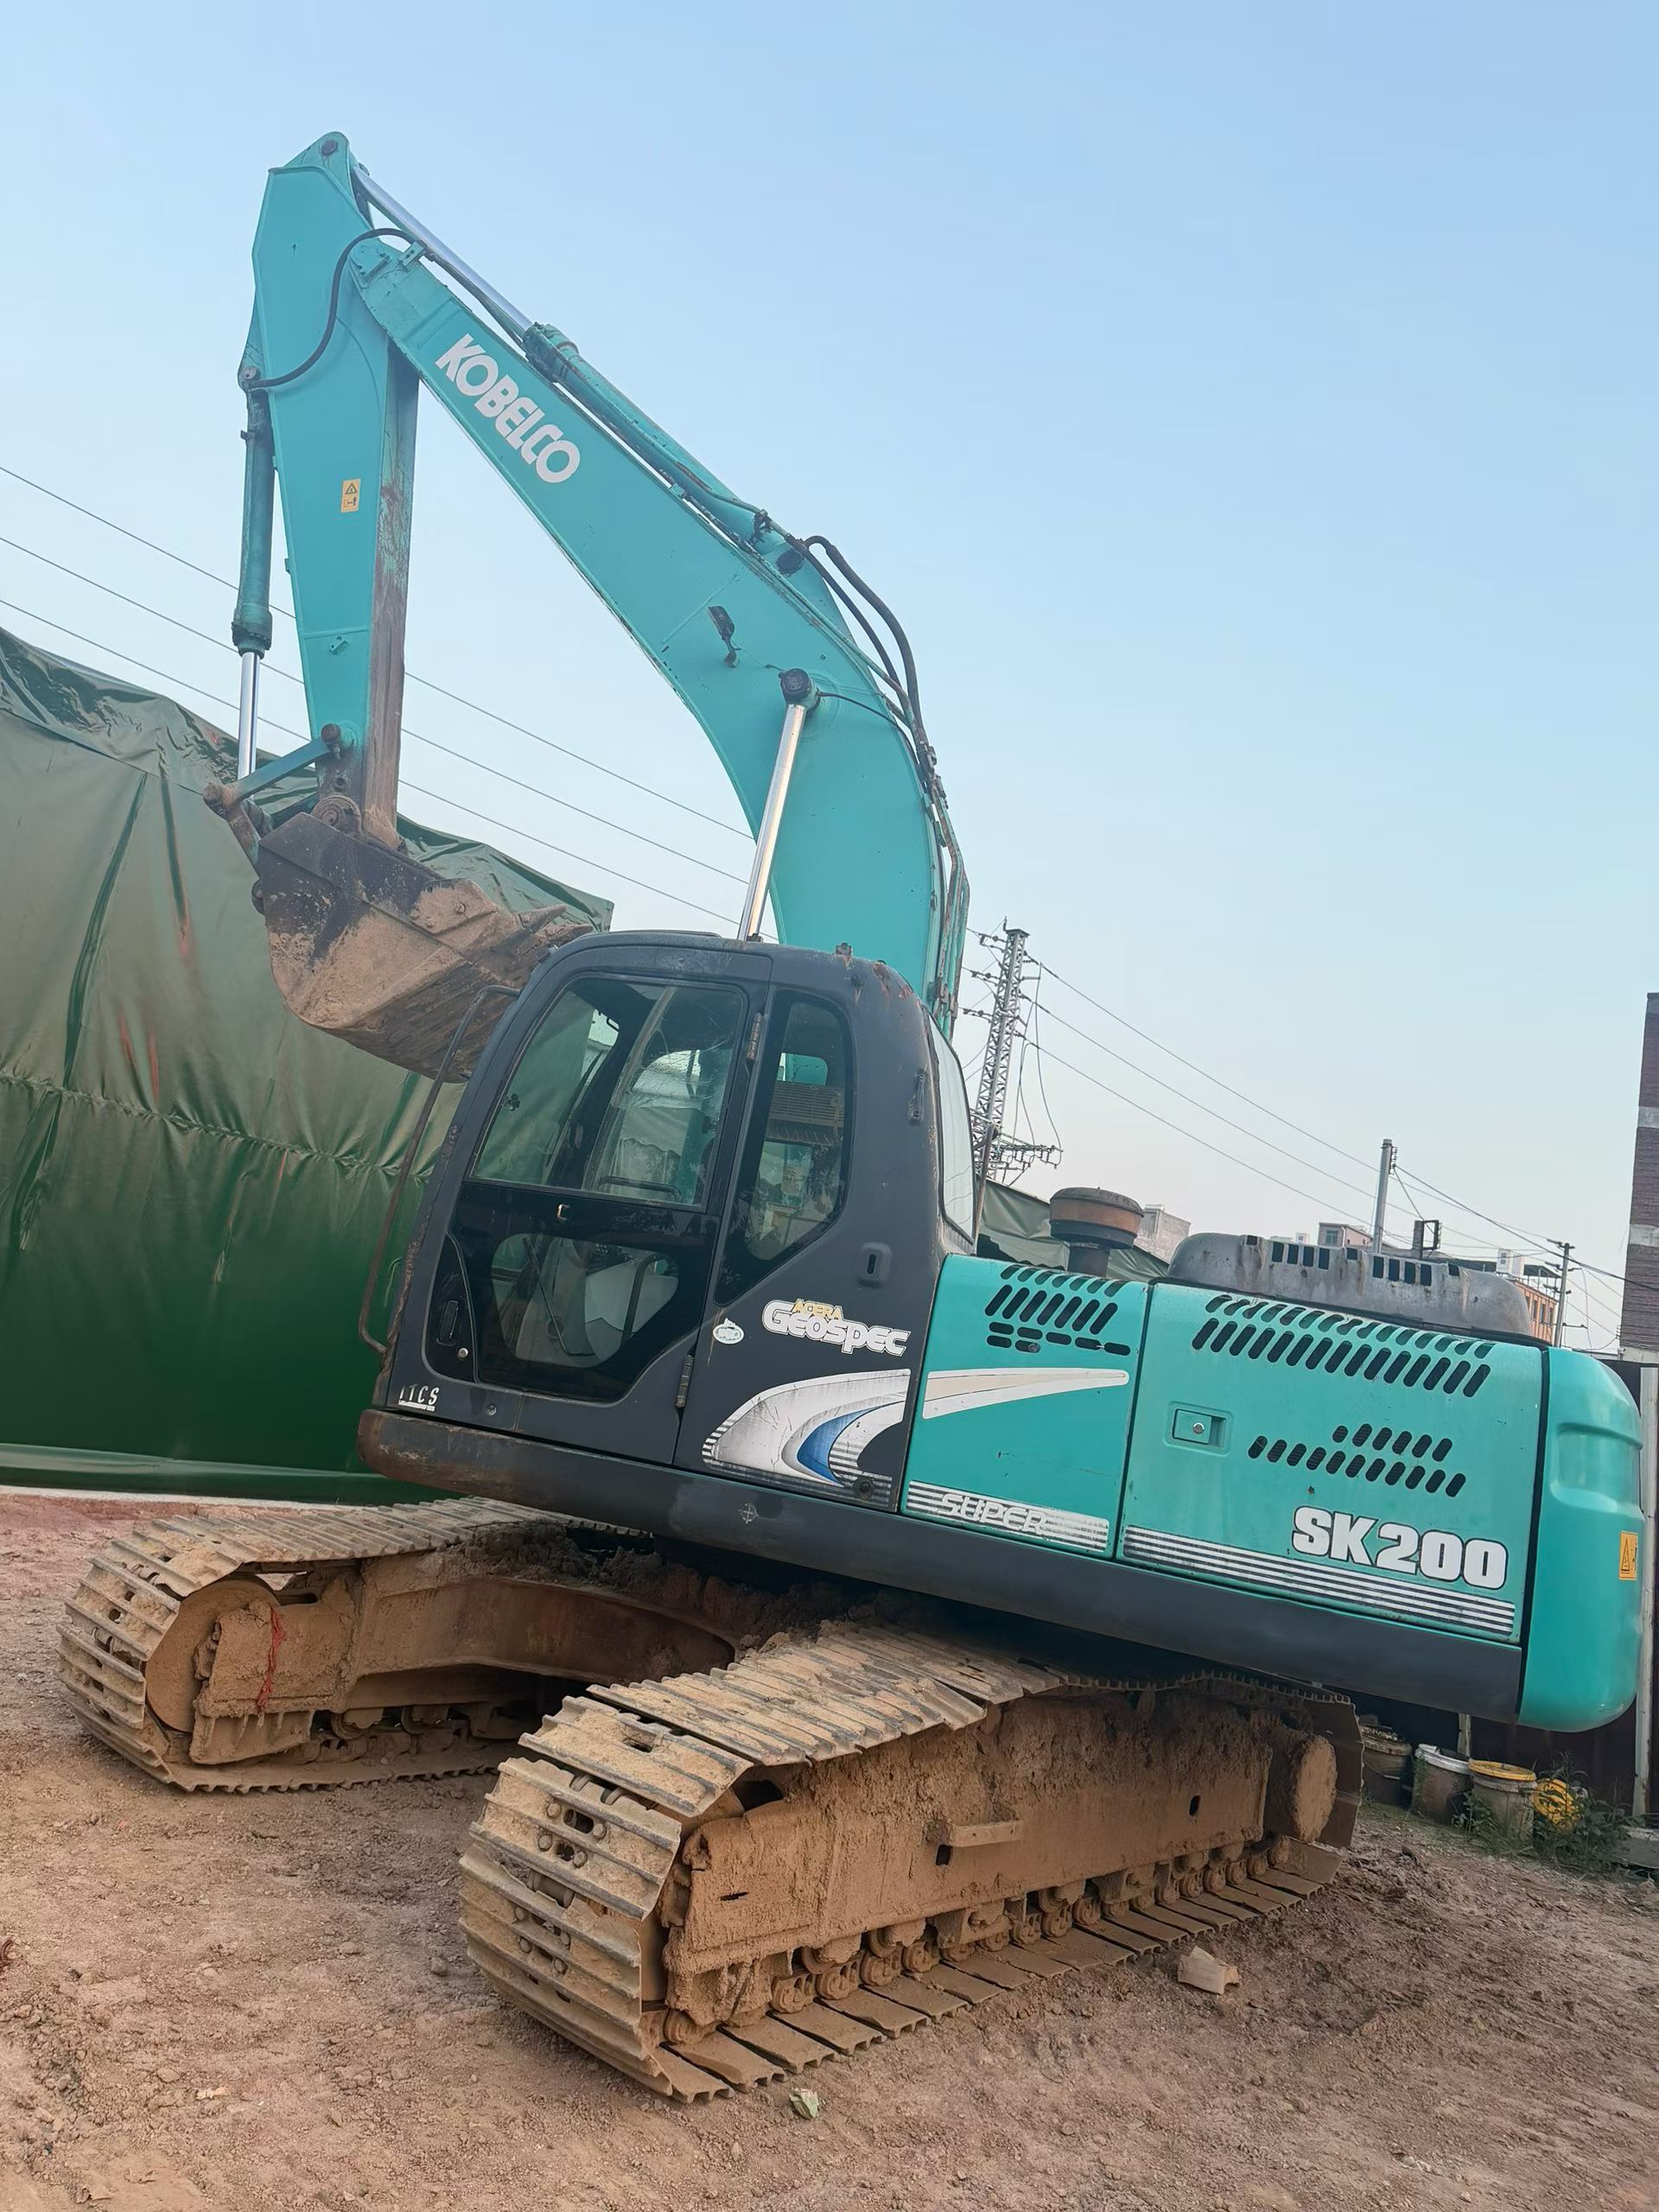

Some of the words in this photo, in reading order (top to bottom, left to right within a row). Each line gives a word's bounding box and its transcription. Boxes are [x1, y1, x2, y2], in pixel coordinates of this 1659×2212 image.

[435, 333, 581, 484] KOBELCO
[941, 1492, 1048, 1535] SUPER
[1292, 1506, 1507, 1590] SK200
